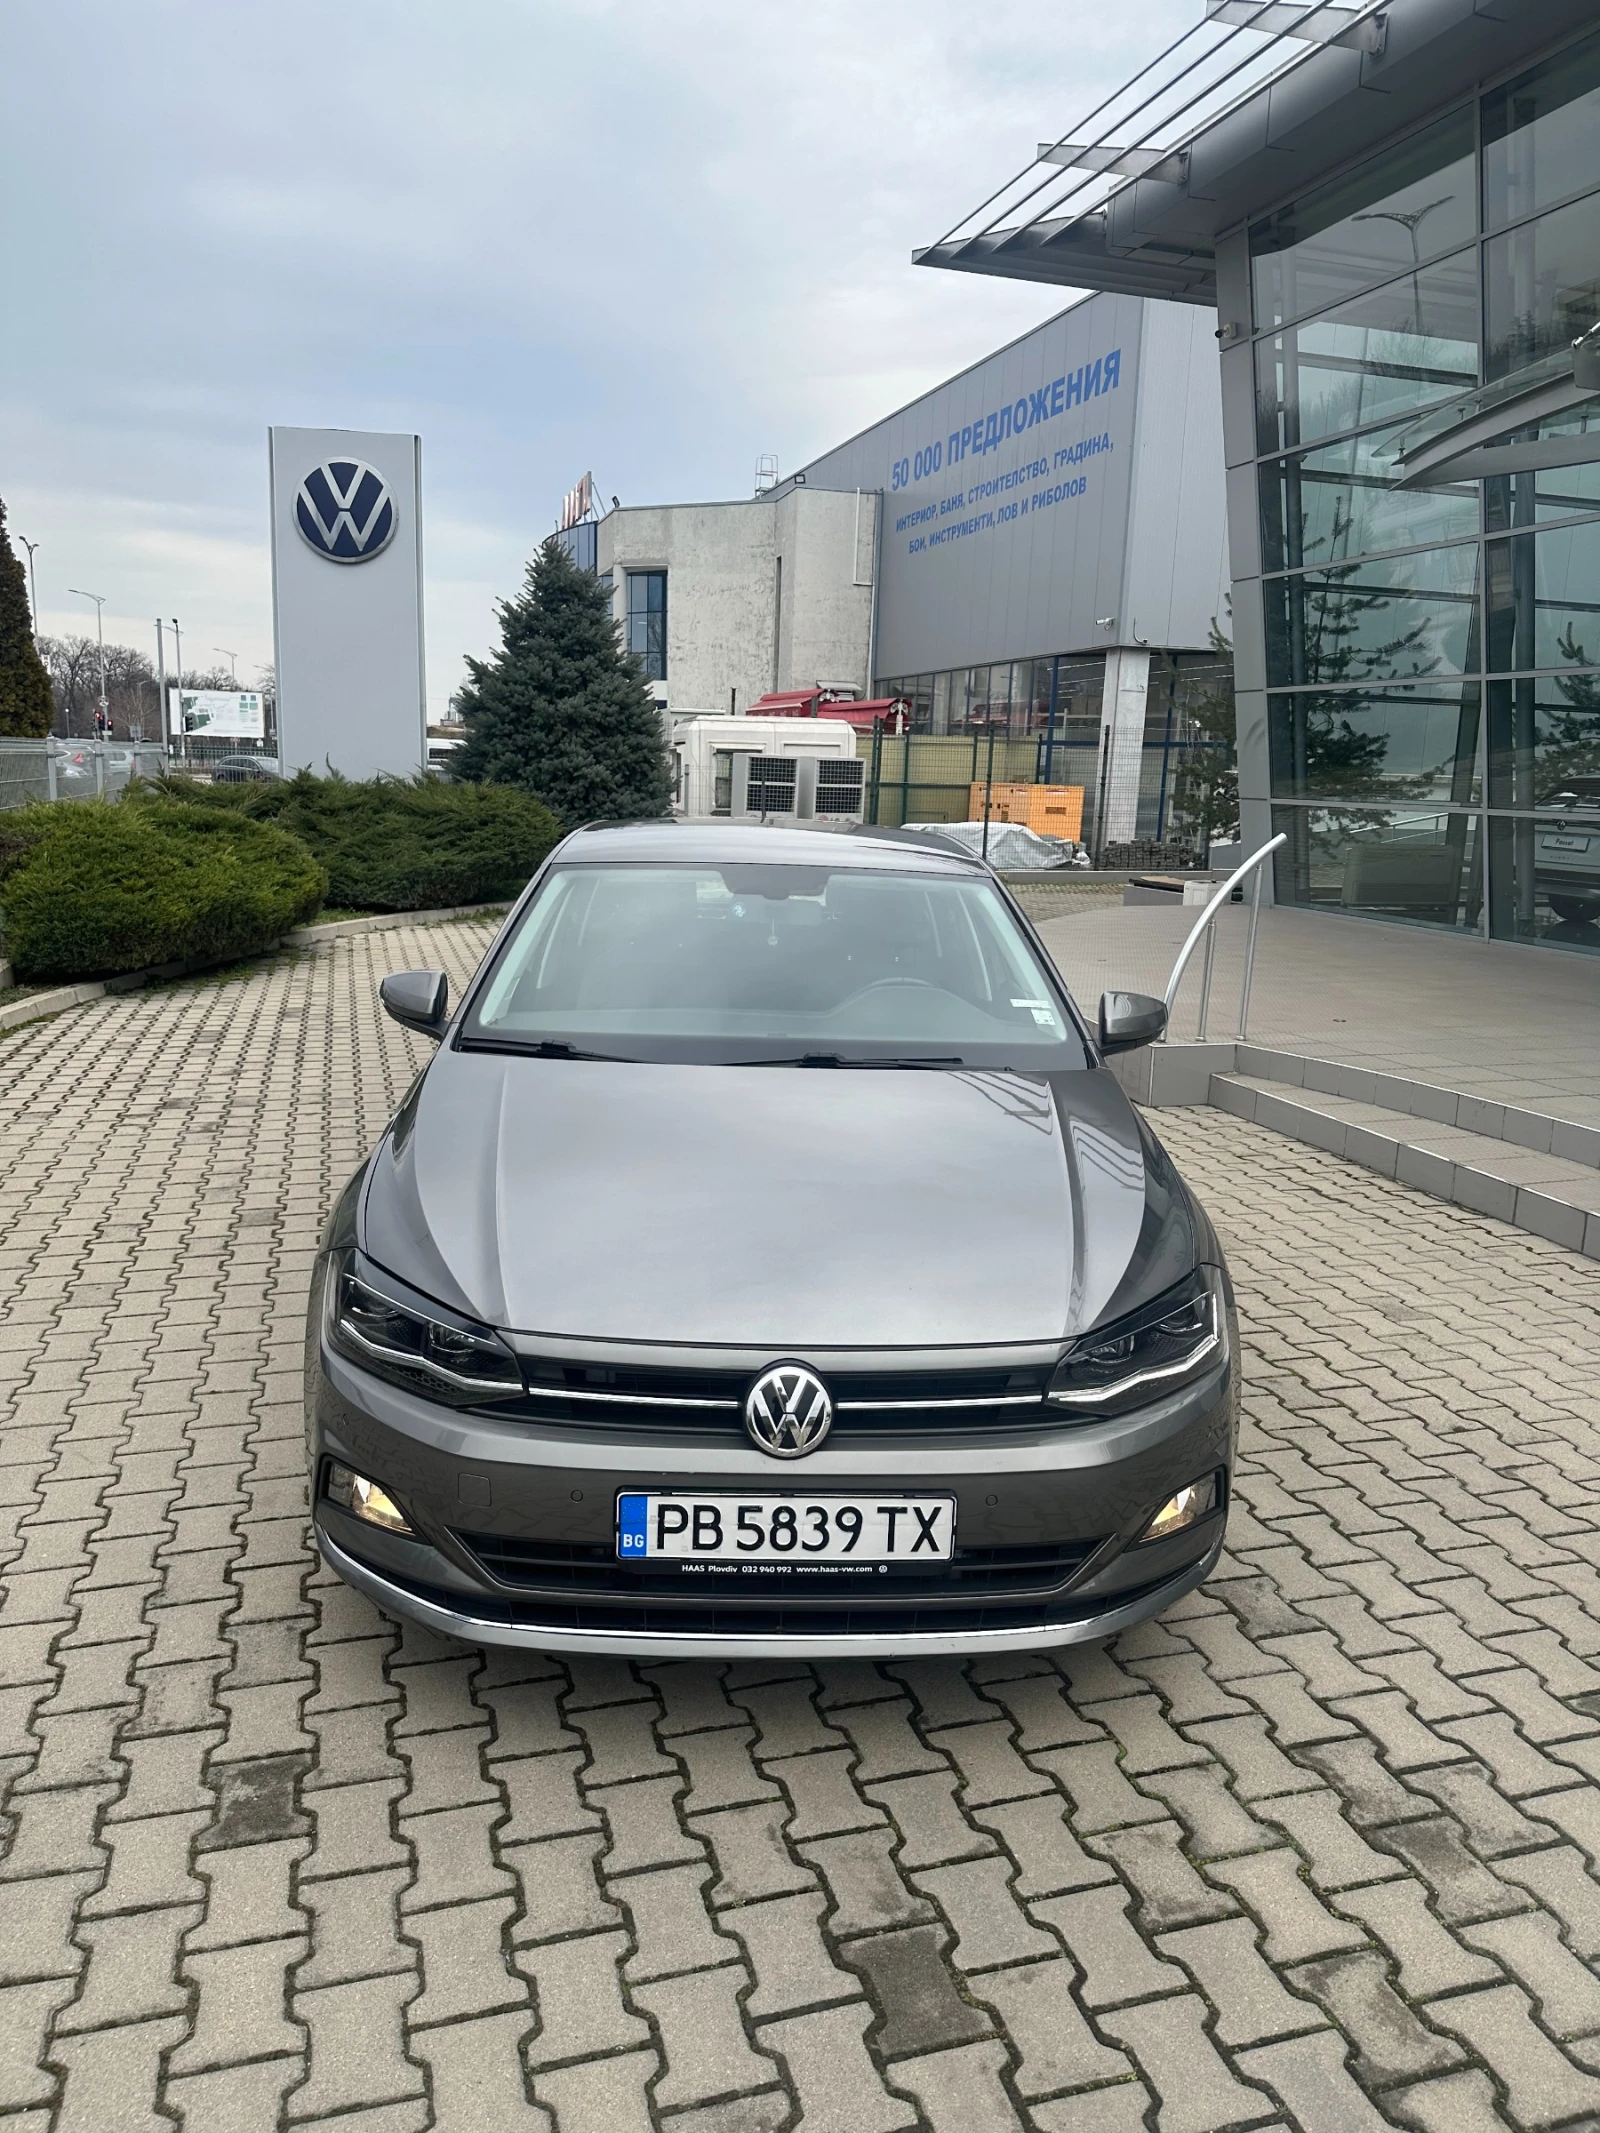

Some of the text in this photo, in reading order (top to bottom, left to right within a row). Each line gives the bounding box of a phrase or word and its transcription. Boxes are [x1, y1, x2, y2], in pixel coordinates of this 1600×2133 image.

[892, 348, 1121, 491] 50 000 ПРЕДЛОЖЕНИЯ
[896, 432, 1114, 532] ИНТЕРИОР, БАНЯ, СТРОИТЕЛСТВО, ГРАДИНА,
[908, 476, 1087, 554] БОИ, ИНСТРУМЕНТИ, ЛОВ И РИБОЛОВ
[622, 1533, 645, 1549] BG
[657, 1503, 943, 1553] PB 5839 TX
[681, 1564, 705, 1573] HAAS
[708, 1564, 738, 1573] Plovdiv
[742, 1565, 758, 1573] 032
[759, 1565, 775, 1573] 940
[776, 1565, 792, 1574] 992
[796, 1564, 873, 1573] www.haas-vw.com
